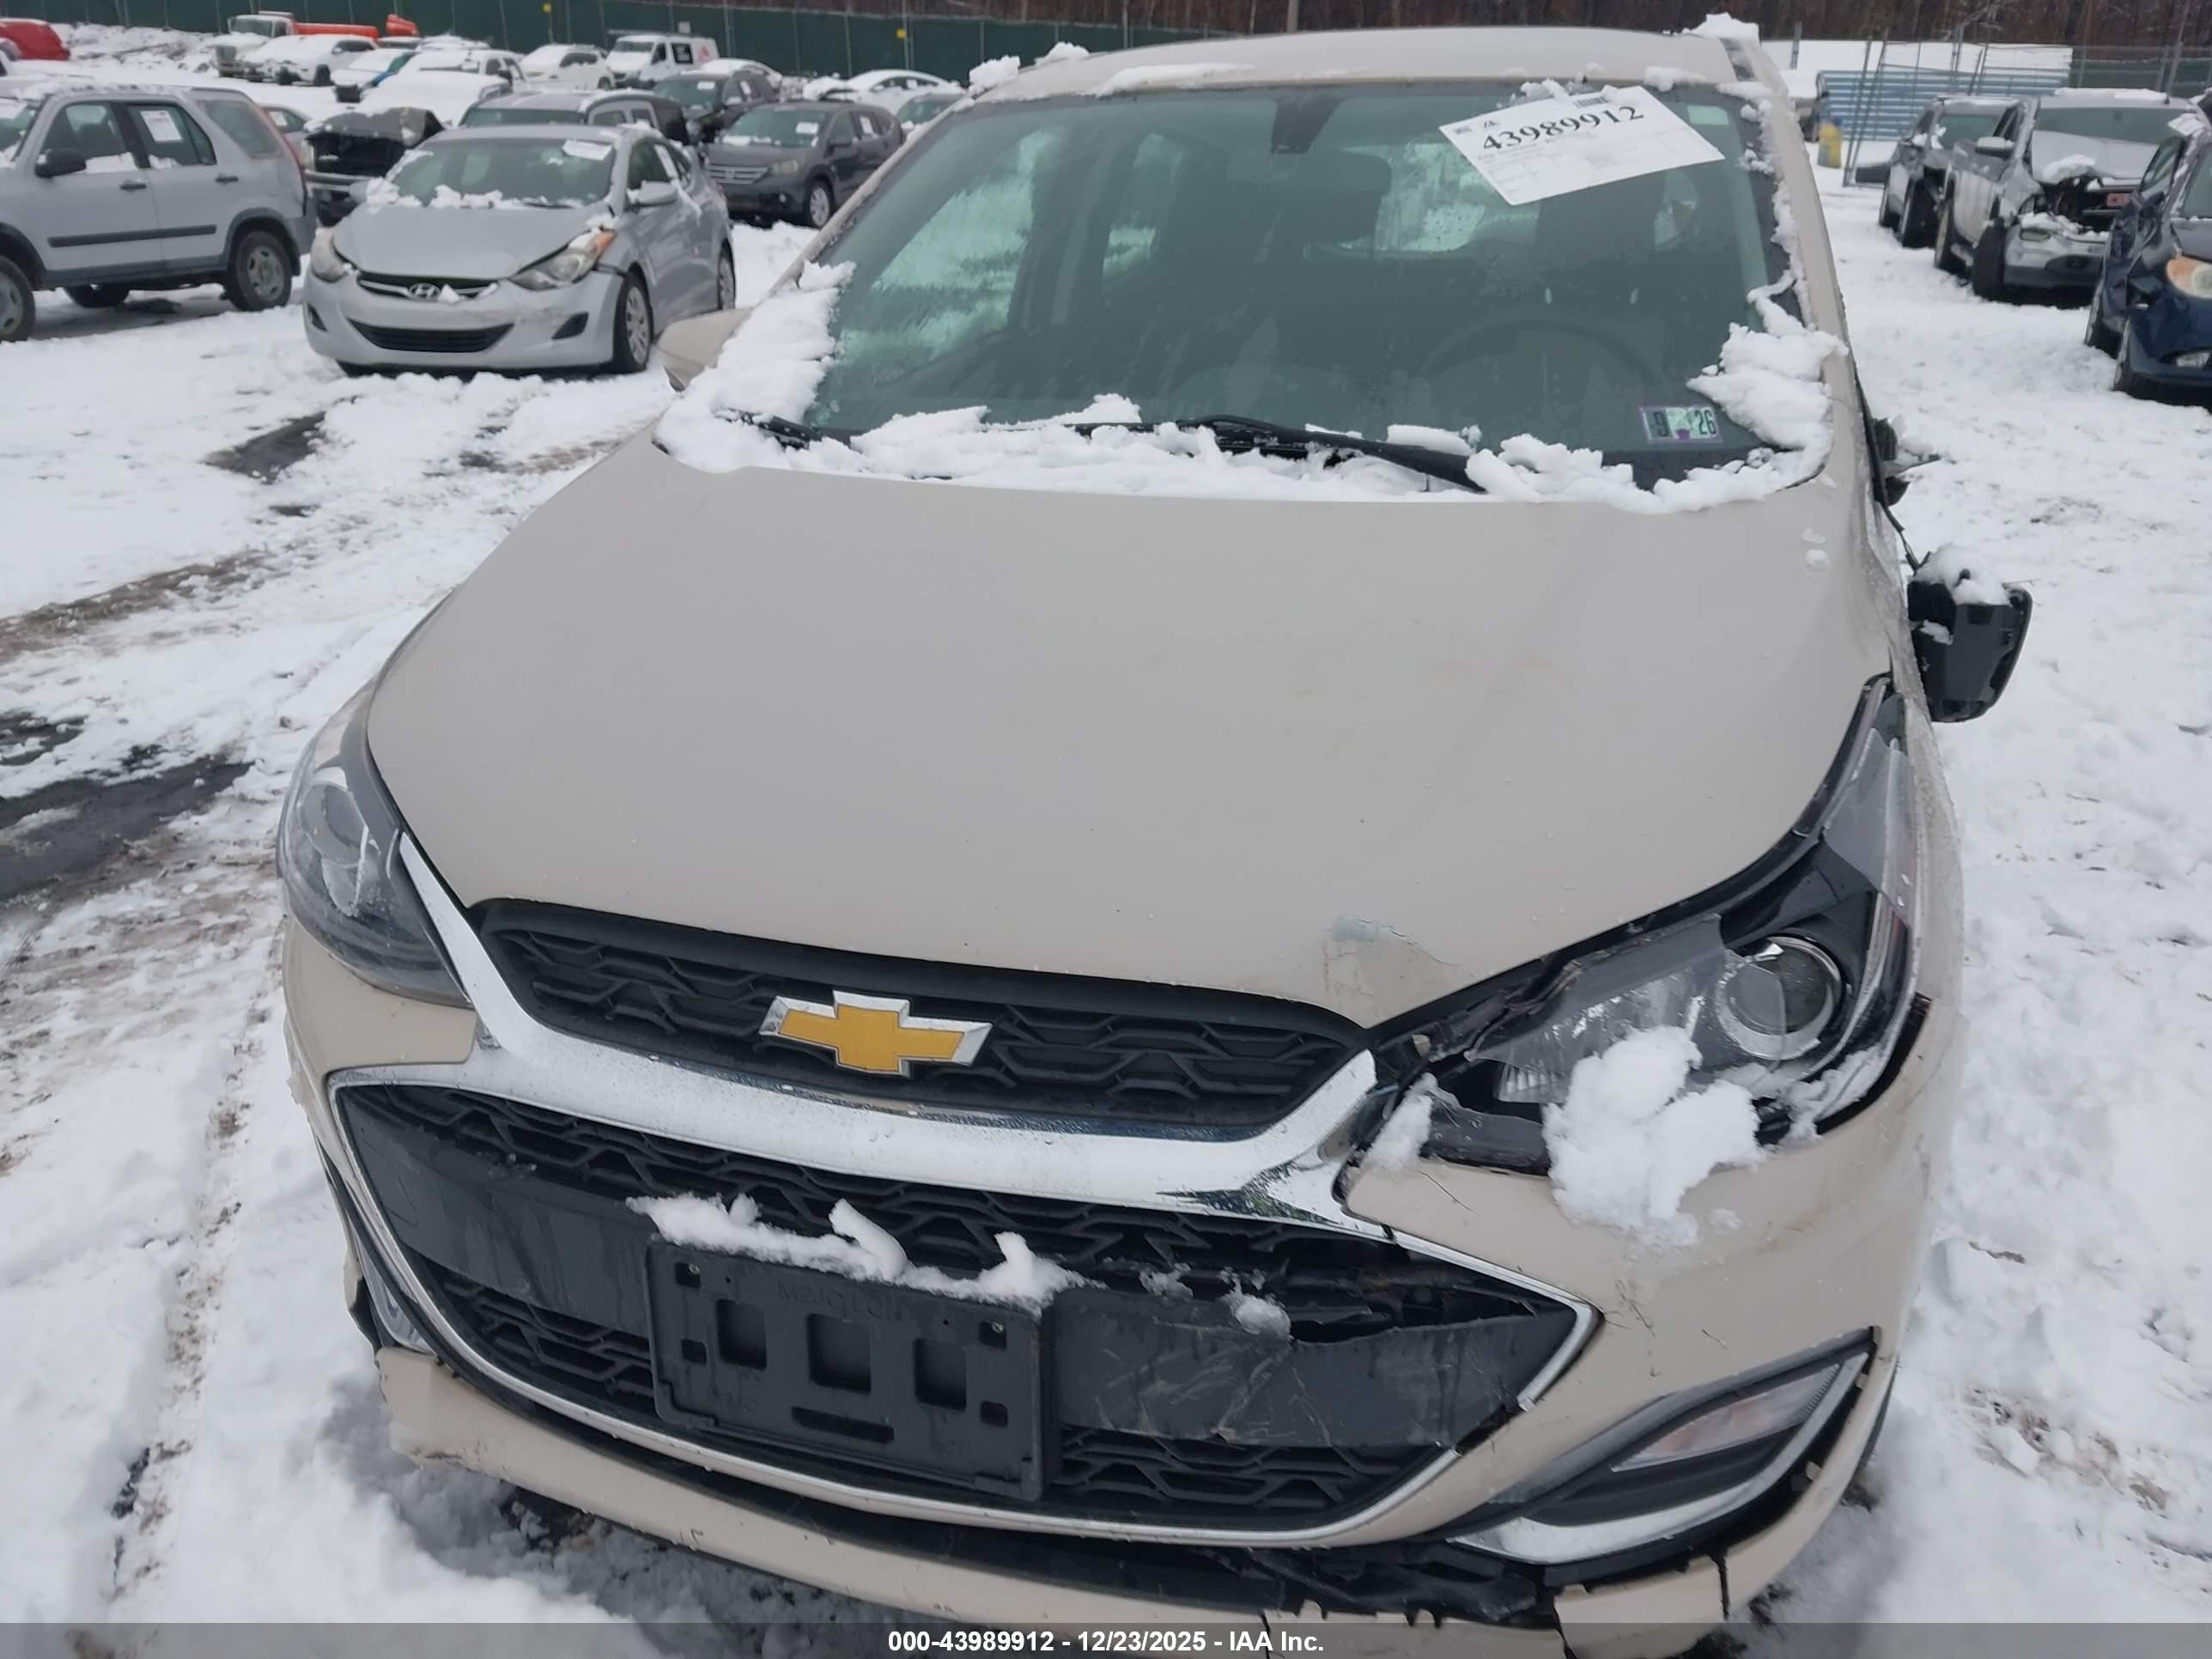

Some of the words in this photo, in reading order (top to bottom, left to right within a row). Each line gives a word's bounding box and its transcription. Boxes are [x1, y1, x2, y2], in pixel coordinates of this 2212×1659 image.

[1483, 106, 1644, 149] 43989912
[1653, 411, 1669, 437] 9
[1694, 410, 1717, 434] 26
